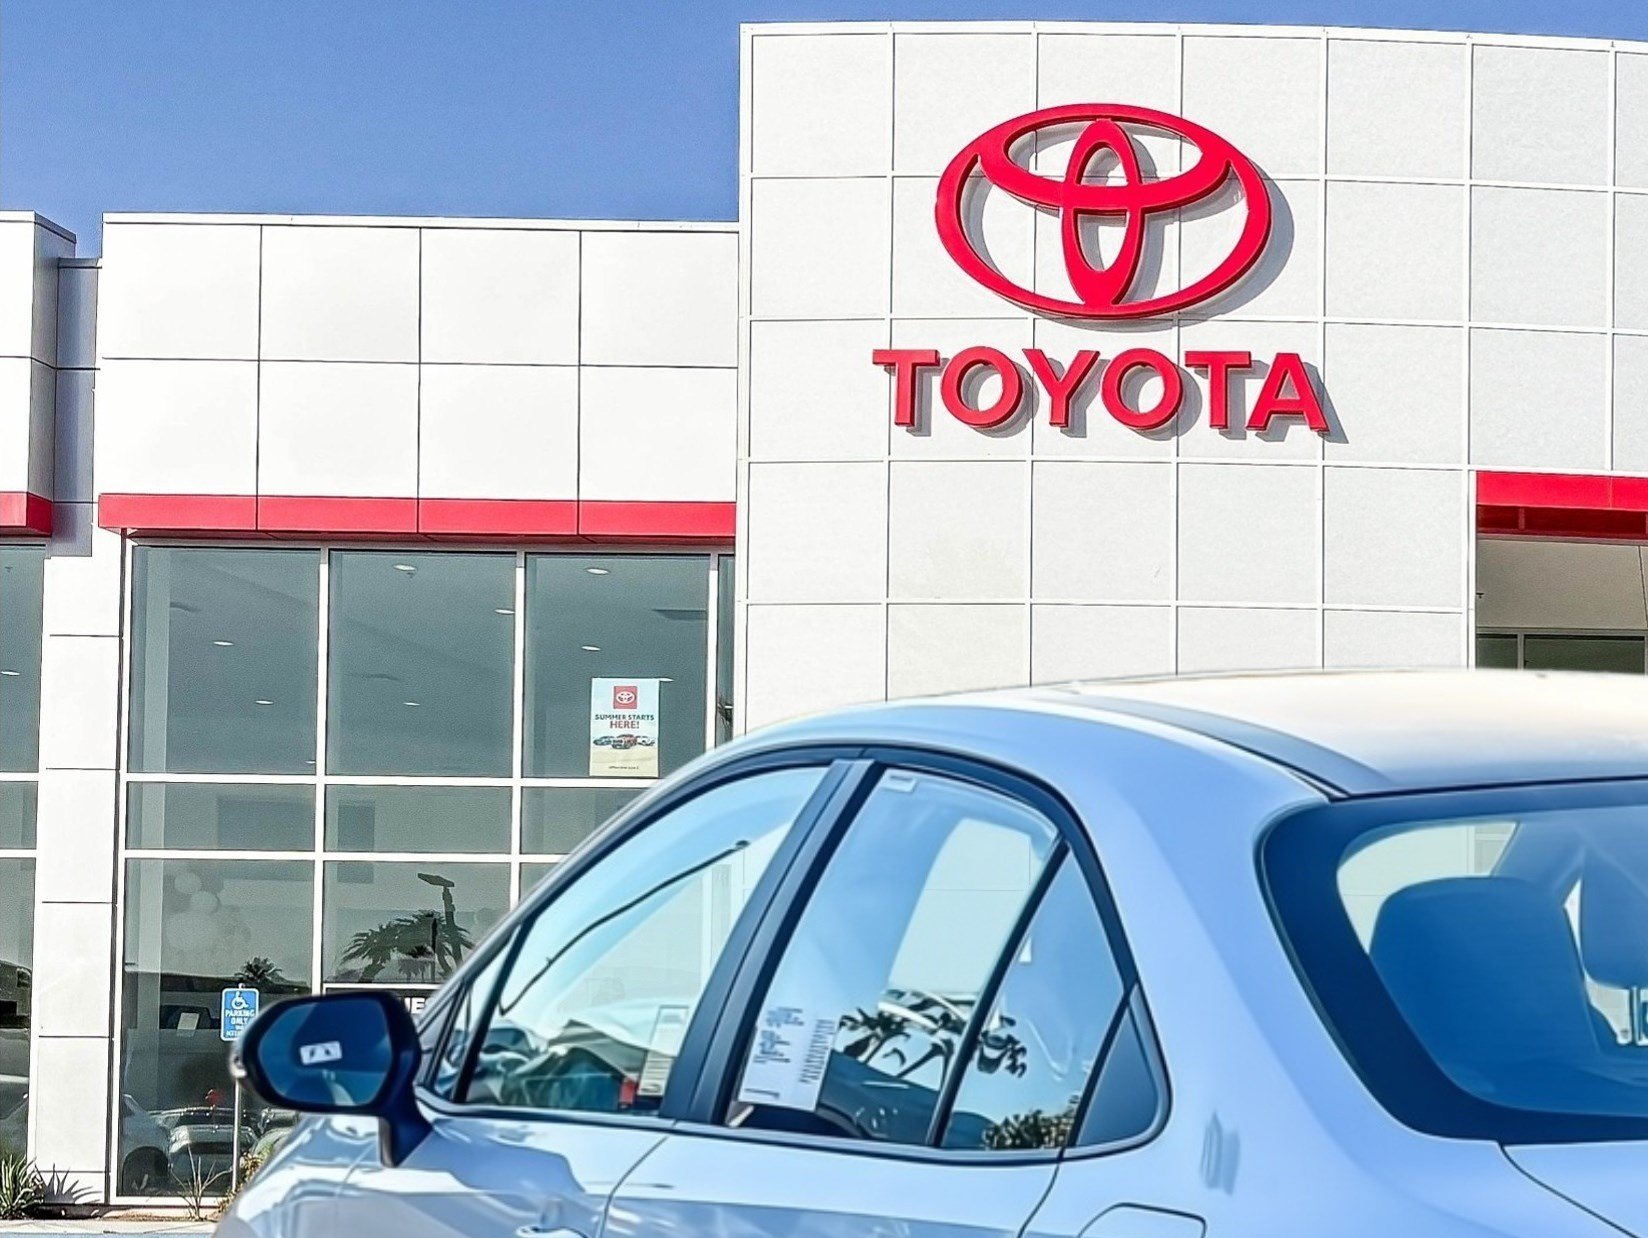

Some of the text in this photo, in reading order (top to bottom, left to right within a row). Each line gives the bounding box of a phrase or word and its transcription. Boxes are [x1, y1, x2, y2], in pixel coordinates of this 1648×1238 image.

[872, 346, 1330, 432] TOYOTA
[609, 720, 640, 729] HERE!
[225, 1010, 255, 1018] PARKING
